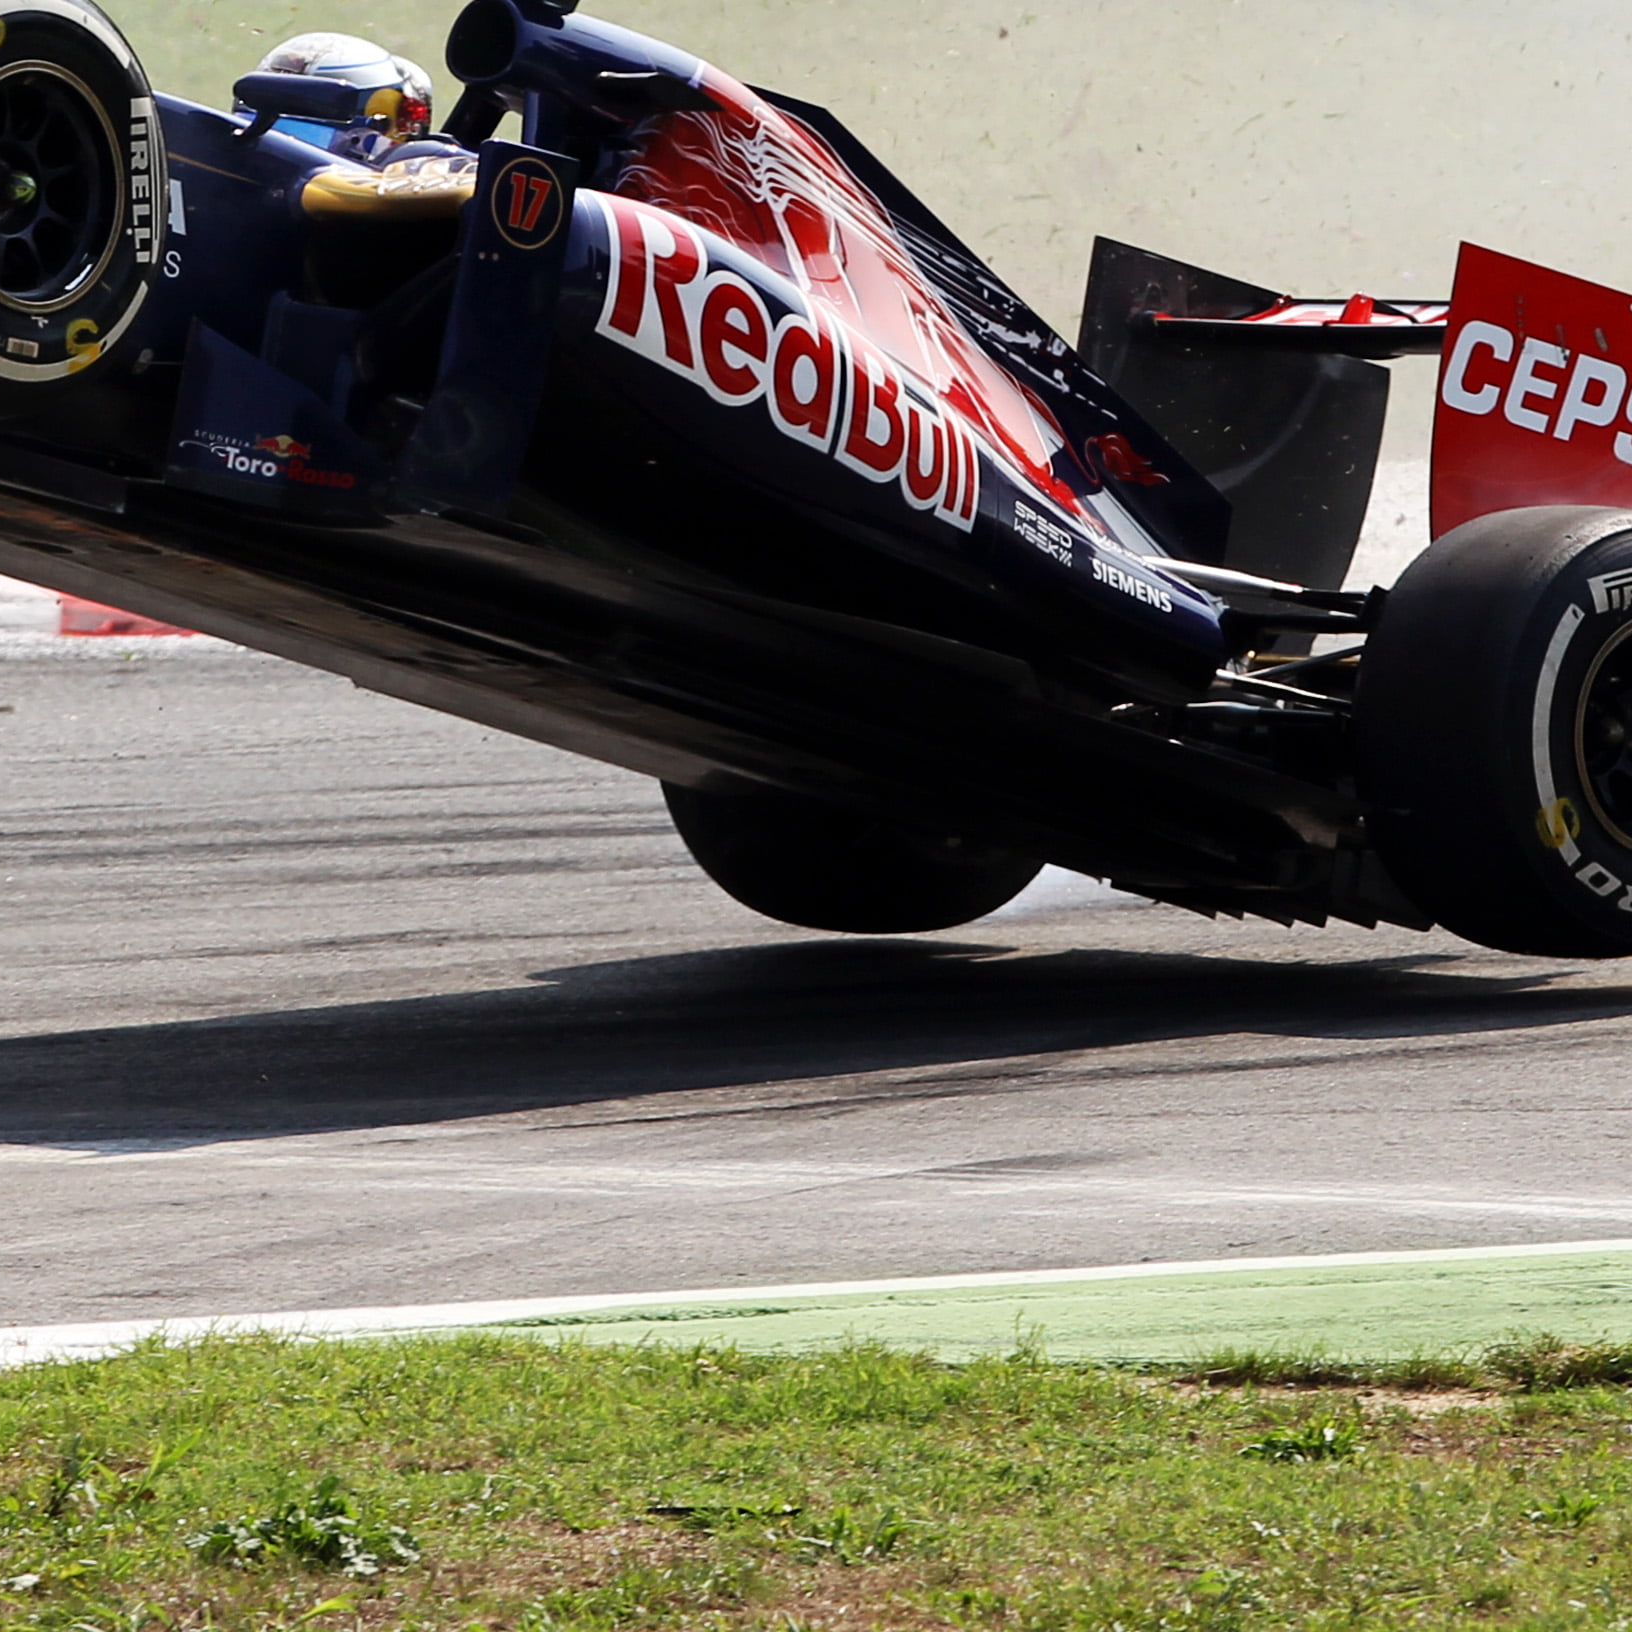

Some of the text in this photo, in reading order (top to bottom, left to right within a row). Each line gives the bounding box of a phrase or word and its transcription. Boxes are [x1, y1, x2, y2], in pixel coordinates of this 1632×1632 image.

[130, 97, 160, 264] PIRELLI
[509, 171, 552, 231] 17
[596, 192, 979, 531] Red Bull
[225, 446, 277, 477] Toro
[1014, 499, 1073, 549] SPEED
[1091, 557, 1173, 613] SIEMENS
